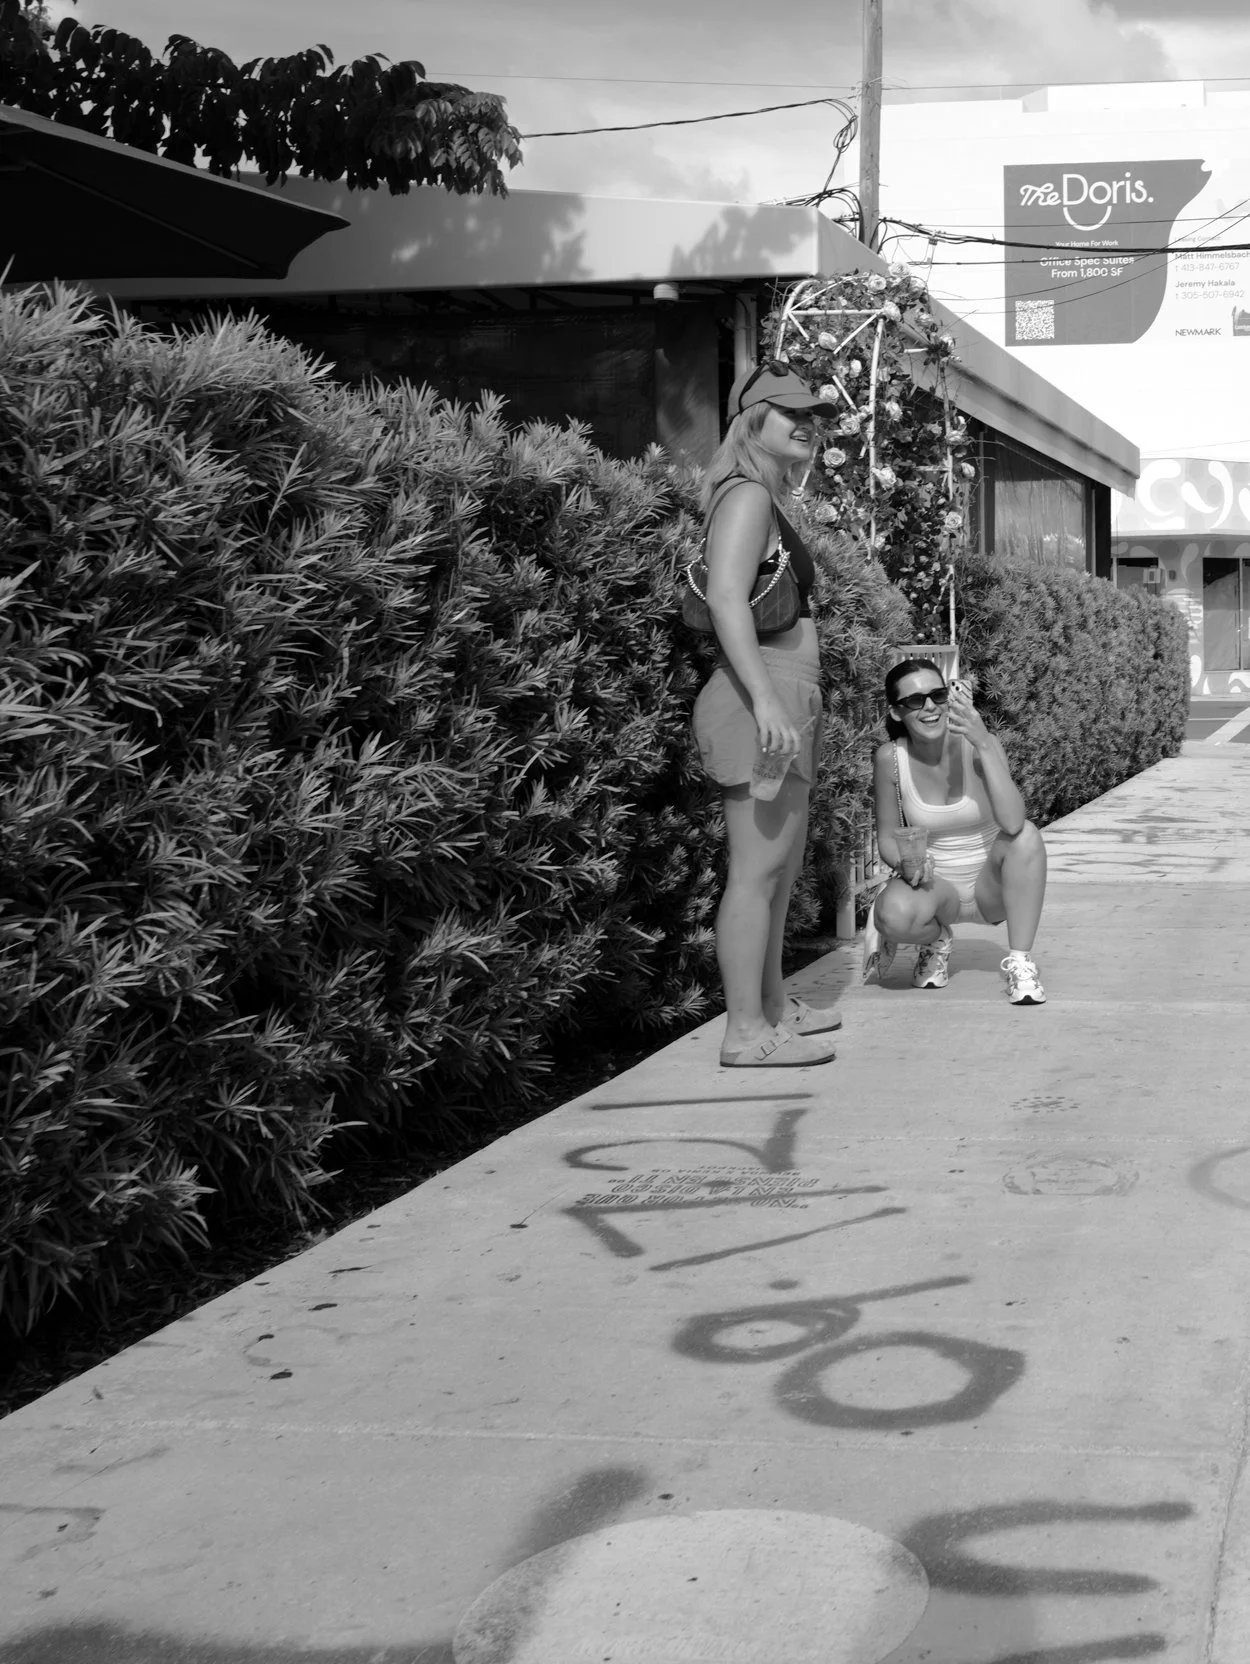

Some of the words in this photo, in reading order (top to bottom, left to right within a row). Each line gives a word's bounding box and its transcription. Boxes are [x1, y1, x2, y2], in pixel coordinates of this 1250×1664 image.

[1019, 182, 1062, 207] The
[1071, 240, 1090, 248] Home
[1101, 239, 1119, 247] Work
[1175, 252, 1194, 260] Matt
[1040, 256, 1072, 267] Office
[1074, 255, 1101, 268] Spec
[1103, 255, 1135, 265] Suites
[1051, 268, 1078, 279] From
[1080, 267, 1109, 279] 1,800
[1110, 267, 1124, 277] SF
[1175, 280, 1206, 289] Jeremy
[1207, 279, 1236, 287] Hakala
[1175, 327, 1222, 337] NEWMARK
